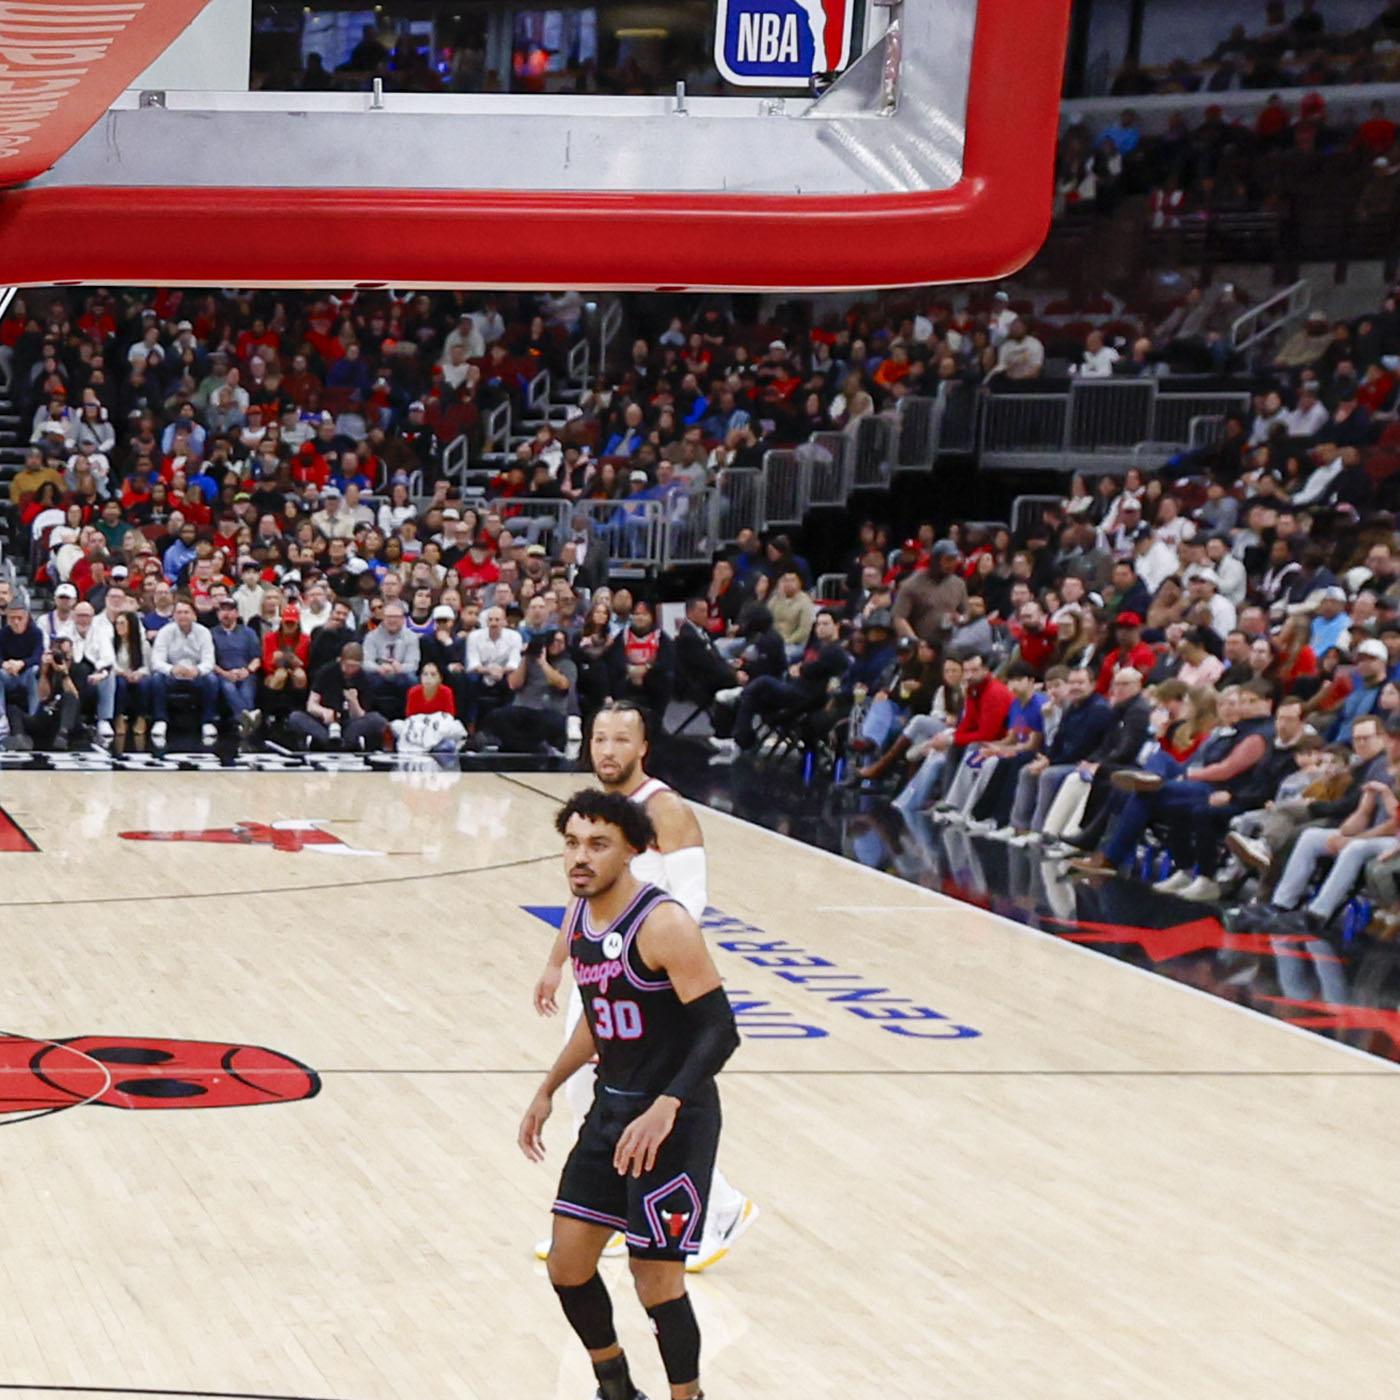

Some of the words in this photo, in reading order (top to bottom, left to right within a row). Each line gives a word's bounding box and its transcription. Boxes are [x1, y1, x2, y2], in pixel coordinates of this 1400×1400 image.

[737, 12, 799, 63] NBA
[571, 957, 624, 994] hicago
[716, 940, 983, 1039] CENTER
[591, 997, 643, 1040] 30
